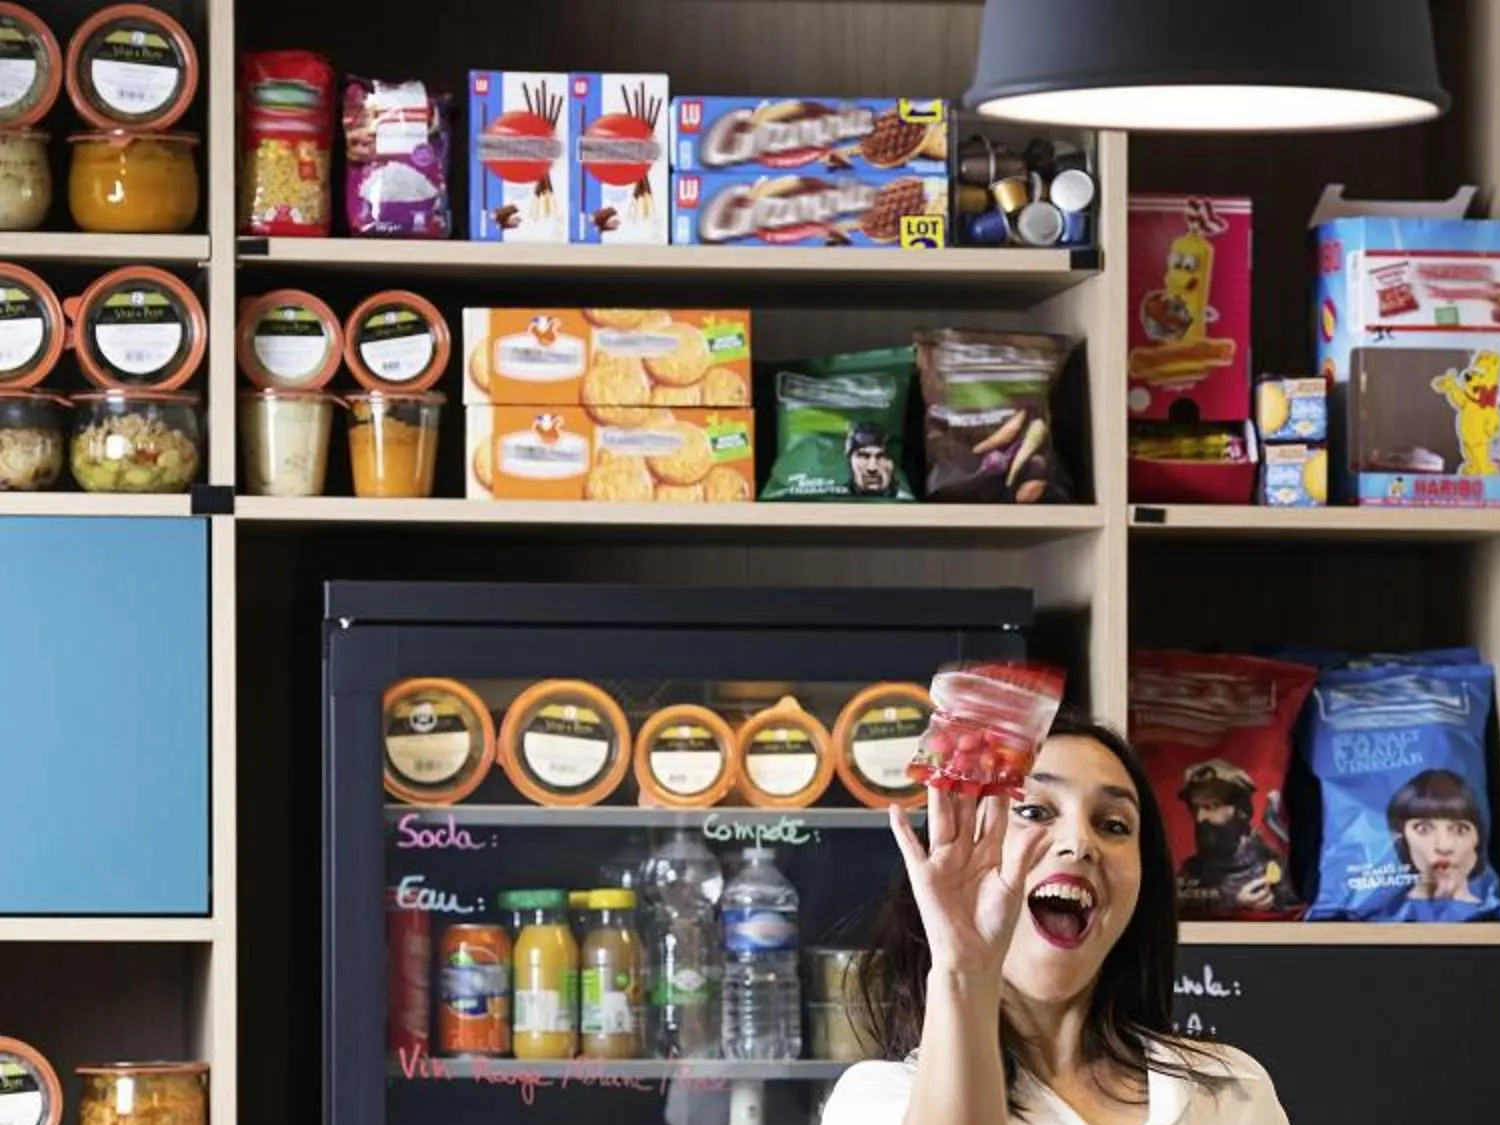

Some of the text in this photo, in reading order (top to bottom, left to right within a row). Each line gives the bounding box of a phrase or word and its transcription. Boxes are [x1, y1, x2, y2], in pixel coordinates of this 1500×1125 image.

[681, 103, 700, 124] LU
[680, 178, 698, 199] LU
[906, 220, 939, 236] LOT
